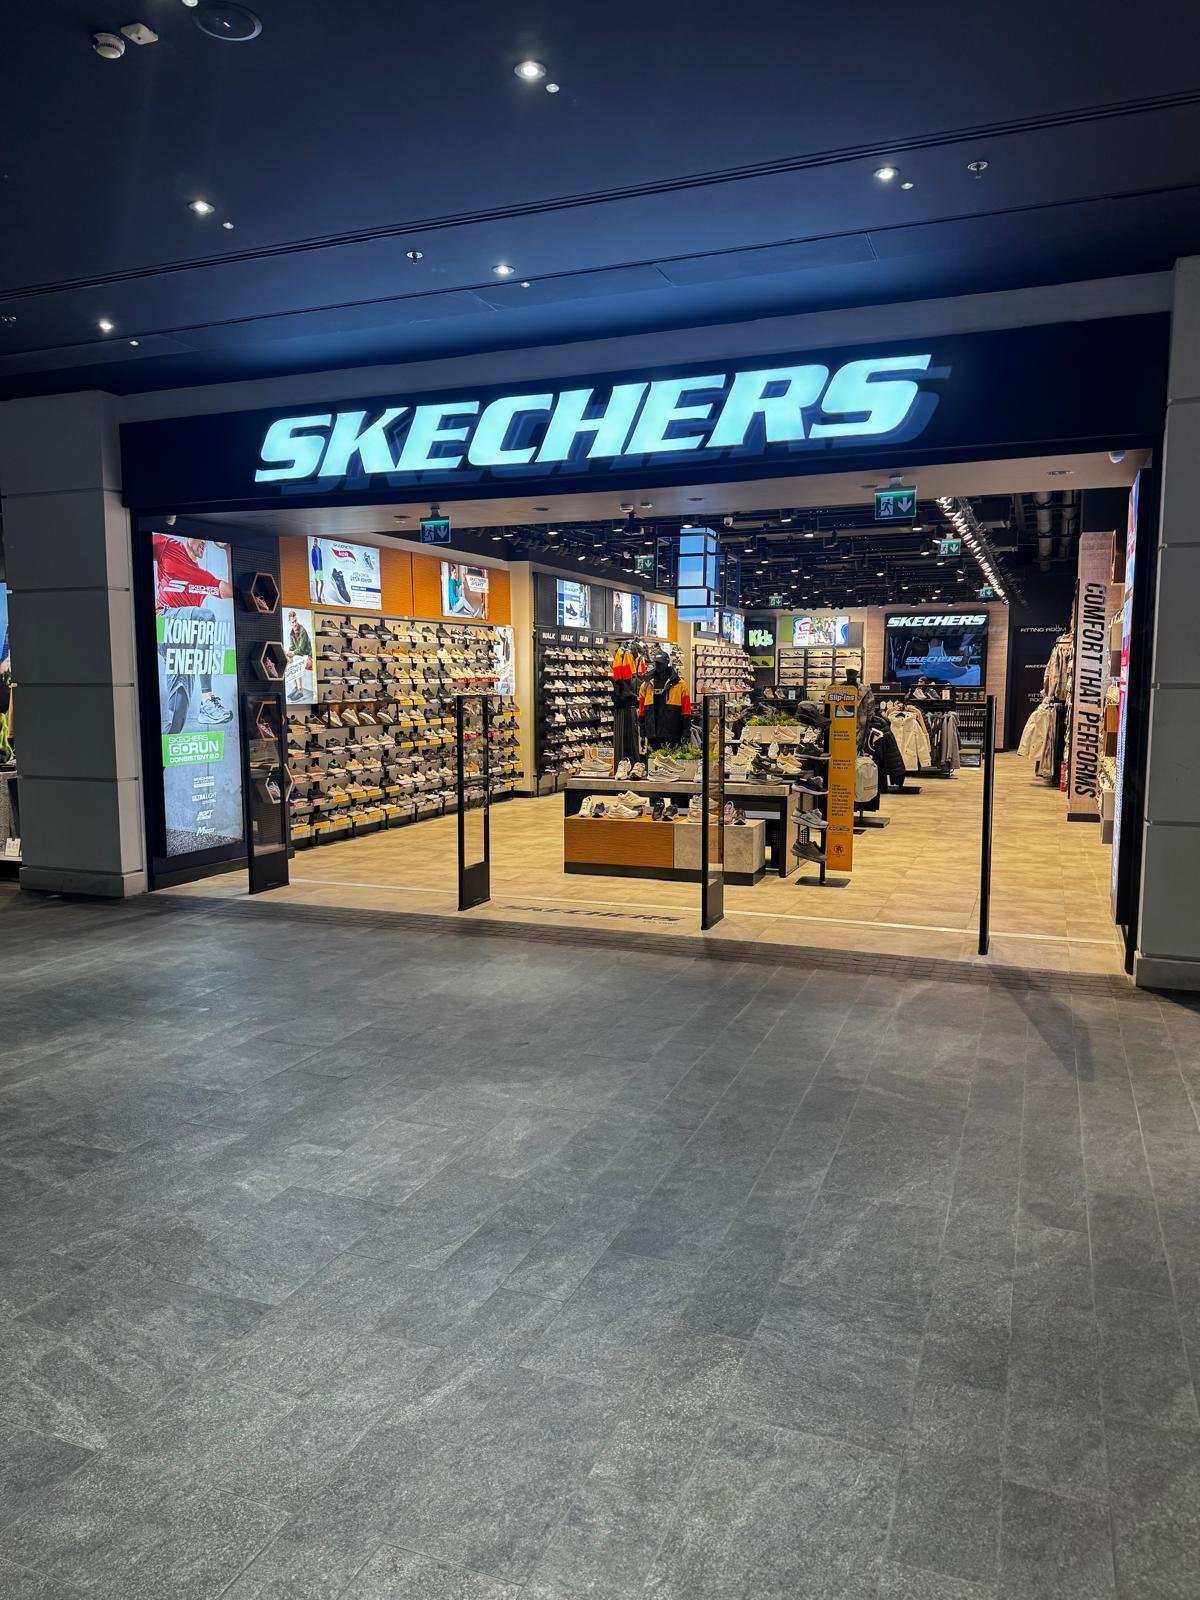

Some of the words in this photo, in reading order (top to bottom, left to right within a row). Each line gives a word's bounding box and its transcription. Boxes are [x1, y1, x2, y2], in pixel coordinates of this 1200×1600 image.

[255, 354, 932, 482] SKECHERS
[188, 584, 219, 593] SKECHERS
[886, 614, 987, 628] SKECHERS
[1081, 582, 1107, 665] COMFORT
[163, 618, 231, 645] KONFORUN
[560, 634, 574, 642] WALK
[748, 629, 774, 647] Kids
[165, 645, 225, 675] ENERJİSİ
[905, 655, 964, 663] SKECHERS
[1079, 667, 1103, 709] THAT
[829, 693, 855, 702] Slip-ins
[168, 734, 209, 744] SKECHERS
[170, 754, 209, 763] CONSISTENT
[1074, 710, 1100, 798] PERFORMS
[500, 905, 685, 921] SKECHERS
